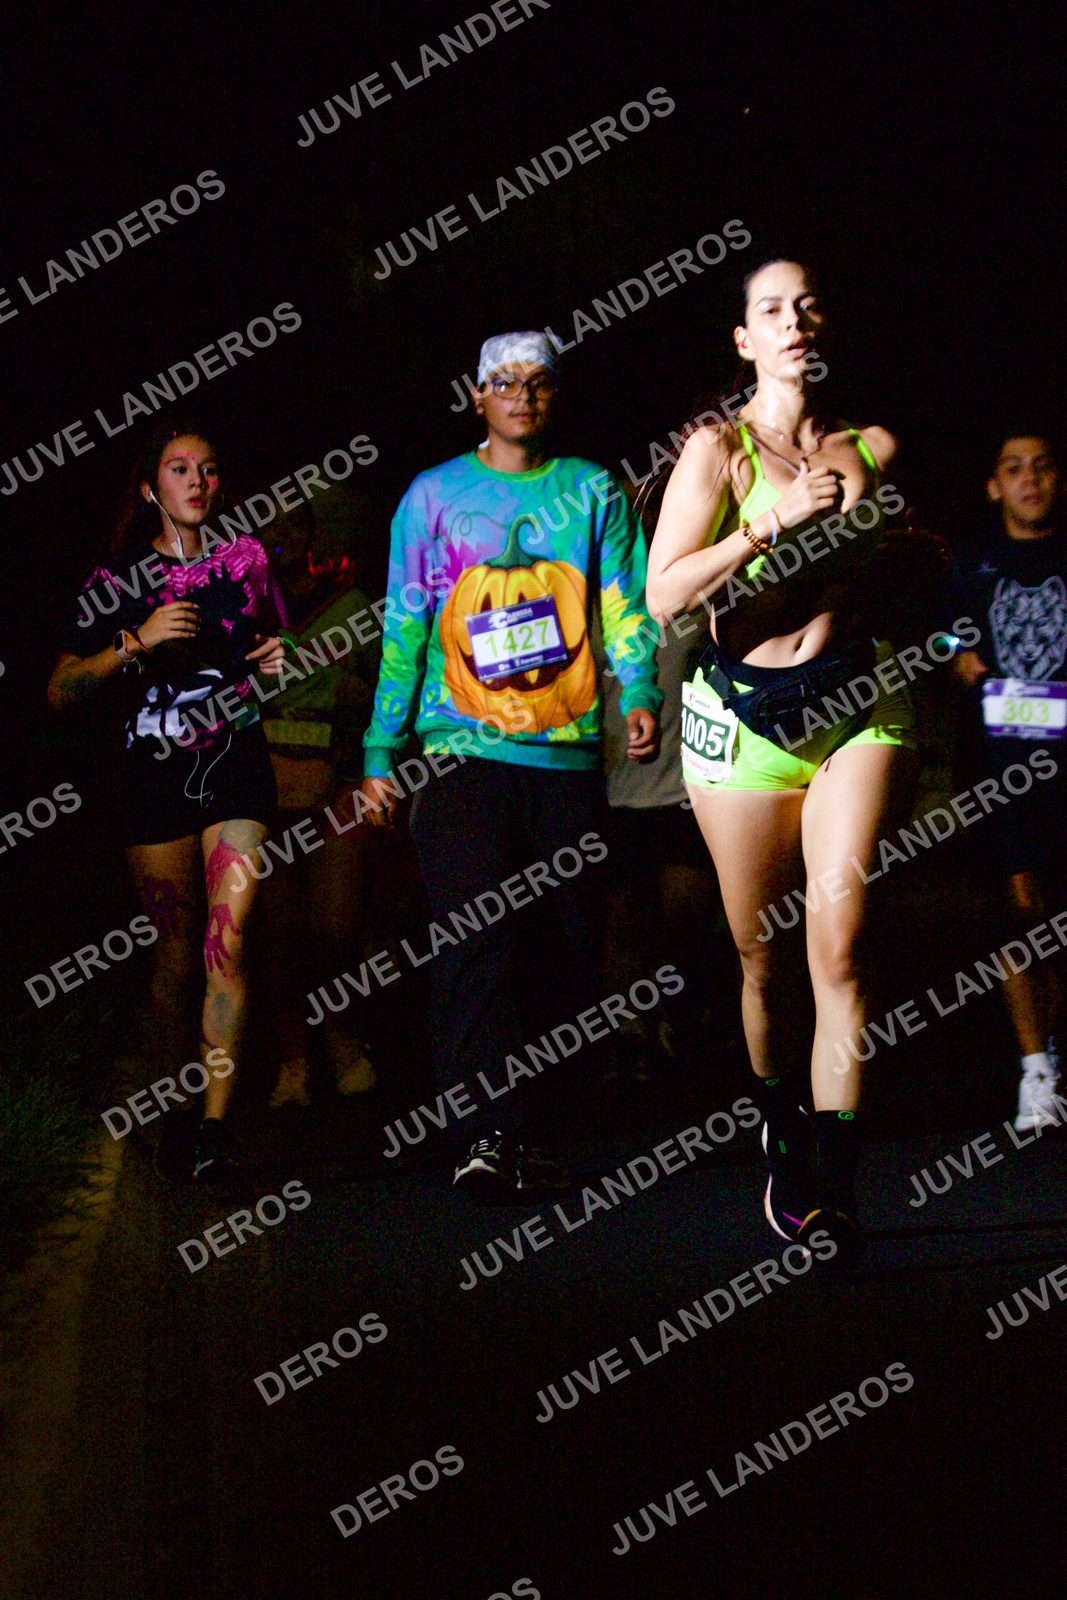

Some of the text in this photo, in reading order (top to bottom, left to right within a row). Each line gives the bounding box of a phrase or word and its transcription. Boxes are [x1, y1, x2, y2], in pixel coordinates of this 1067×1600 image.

[484, 619, 549, 658] 1427
[1002, 700, 1050, 723] 303
[681, 707, 726, 756] 1005
